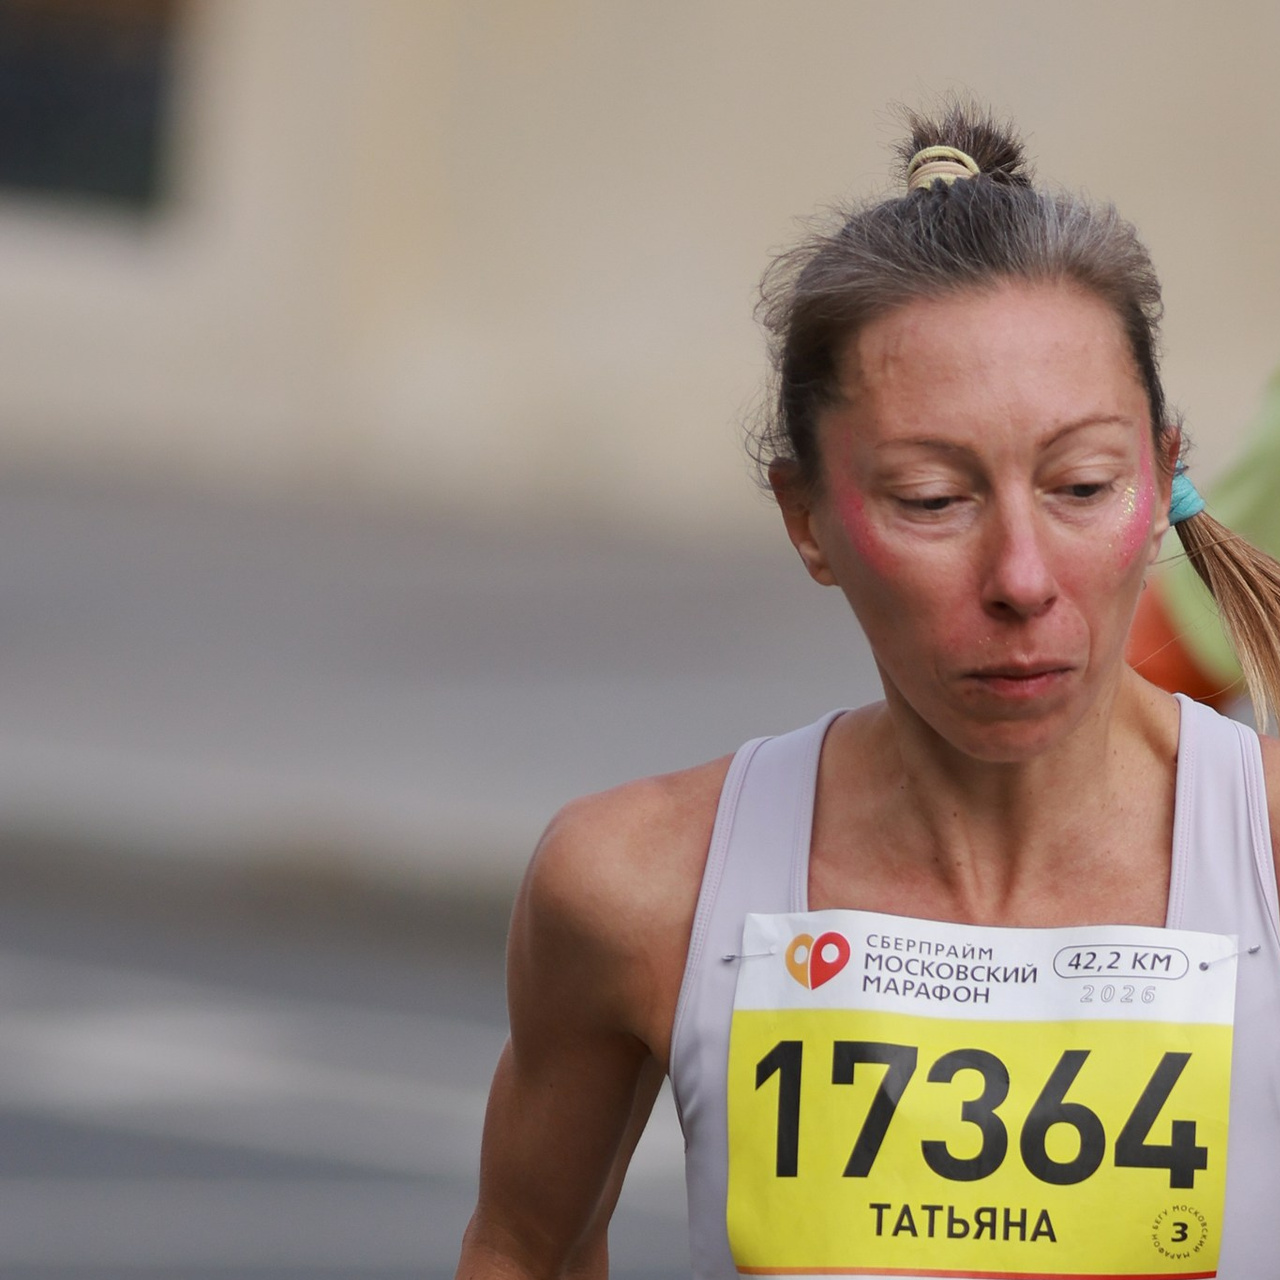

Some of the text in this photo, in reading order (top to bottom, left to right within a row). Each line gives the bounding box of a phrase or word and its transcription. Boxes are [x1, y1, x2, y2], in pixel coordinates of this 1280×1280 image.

[866, 934, 993, 961] СБЕРПРАЙМ
[1068, 951, 1121, 972] 42,2
[864, 952, 1038, 983] МОСКОВСКИЙ
[862, 975, 990, 1004] МАРАФОН
[1080, 984, 1156, 1004] 2026
[755, 1040, 1208, 1189] 17364
[869, 1203, 1057, 1243] ТАТЬЯНА
[1171, 1221, 1188, 1242] 3
